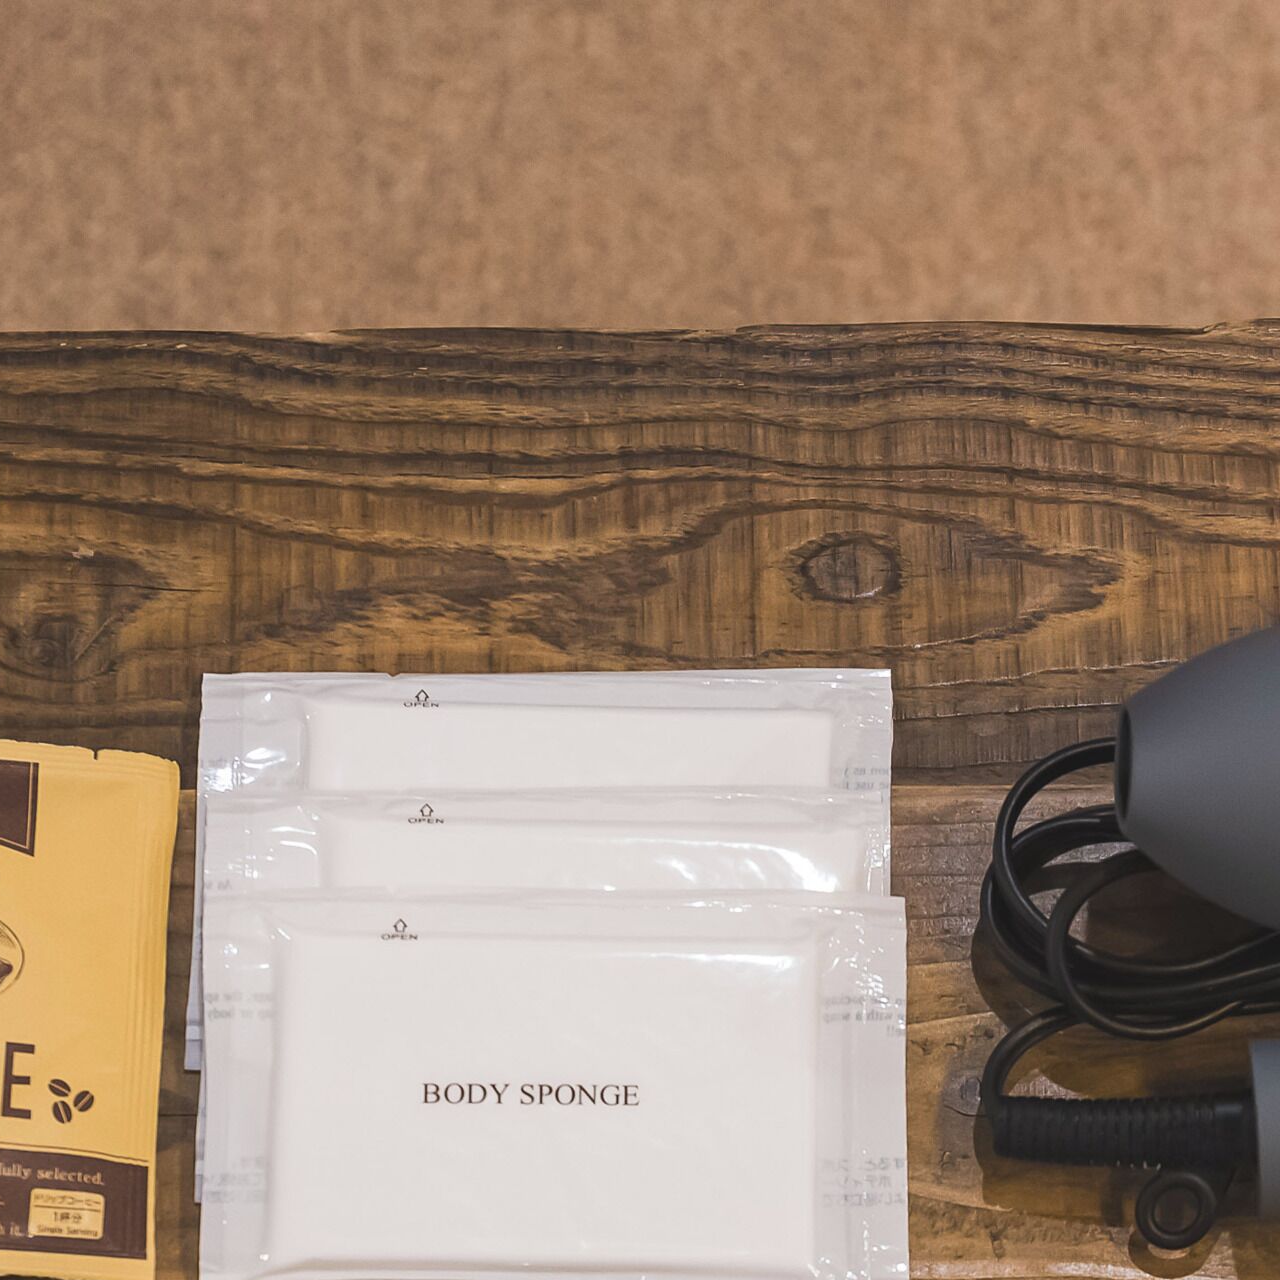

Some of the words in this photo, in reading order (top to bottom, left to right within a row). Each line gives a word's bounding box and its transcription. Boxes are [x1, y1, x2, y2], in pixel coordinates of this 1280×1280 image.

[403, 701, 440, 709] OPEN
[407, 817, 444, 825] OPEN
[381, 933, 419, 941] OPEN
[422, 1082, 510, 1105] BODY
[520, 1083, 640, 1106] SPONGE
[36, 1167, 106, 1186] selected.
